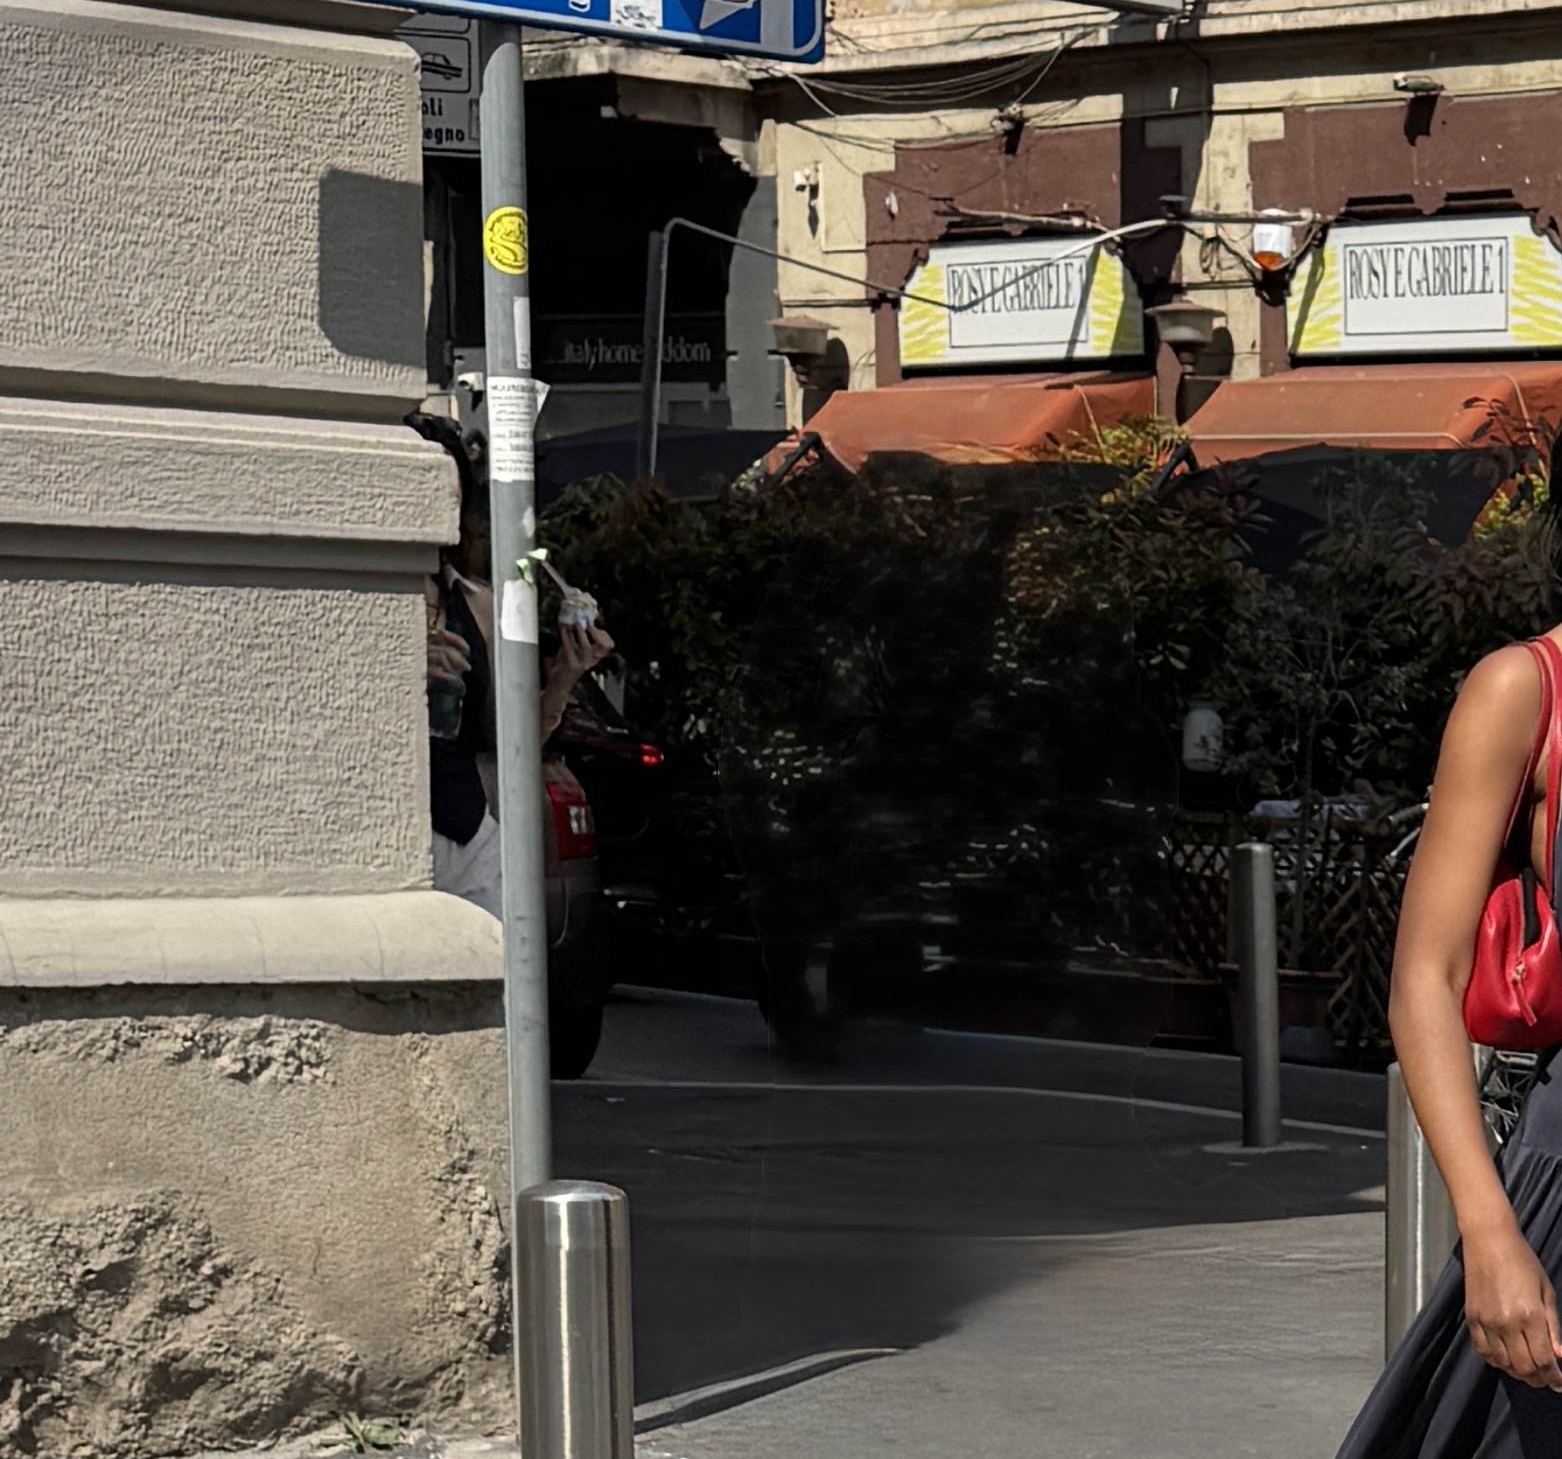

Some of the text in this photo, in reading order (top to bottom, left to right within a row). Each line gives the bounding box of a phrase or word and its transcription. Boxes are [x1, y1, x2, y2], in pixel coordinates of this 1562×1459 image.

[1349, 248, 1390, 300] ROSY
[1394, 247, 1406, 298] E
[1408, 244, 1494, 298] GABRIELE
